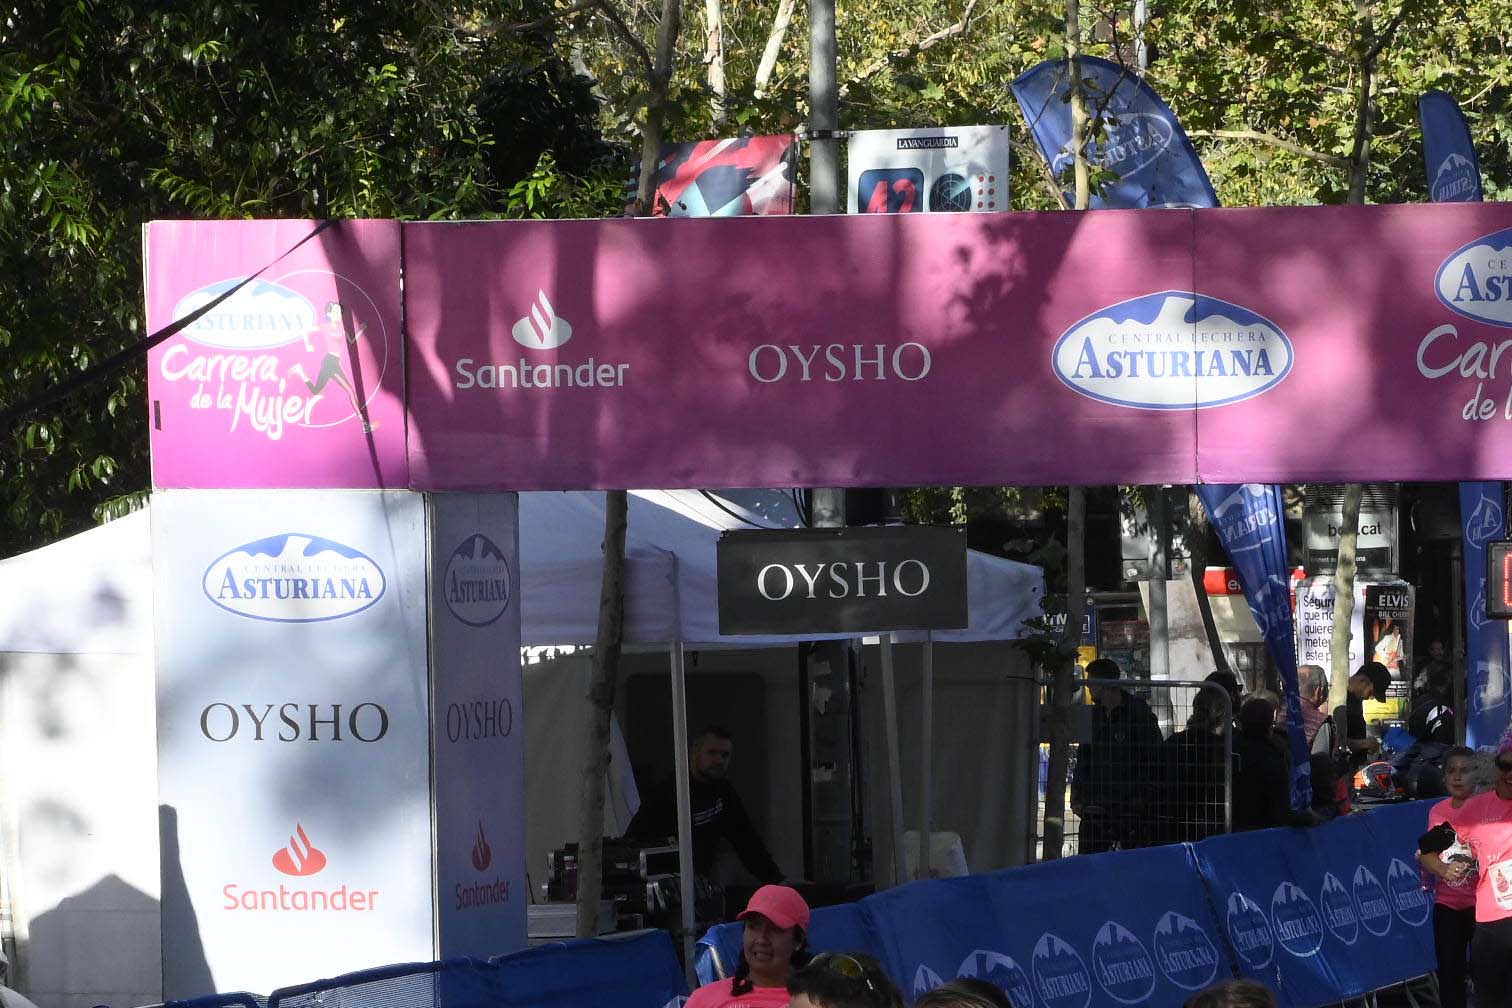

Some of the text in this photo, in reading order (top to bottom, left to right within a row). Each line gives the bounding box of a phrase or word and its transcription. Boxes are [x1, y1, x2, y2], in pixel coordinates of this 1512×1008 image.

[1108, 331, 1266, 344] CENTRAL LECHERA
[160, 344, 279, 381] Carrera
[456, 357, 629, 389] Santander
[748, 341, 932, 384] OYSHO
[1071, 335, 1275, 379] ASTURIANA
[190, 378, 324, 440] de la Mujer
[1462, 384, 1497, 422] de
[217, 566, 373, 600] ASTURIANA
[450, 569, 507, 602] ASTURIANA
[757, 559, 930, 600] OYSHO
[1378, 595, 1409, 606] ELVIS
[199, 702, 389, 742] OYSHO
[446, 697, 513, 743] OYSHO
[222, 884, 380, 910] Santander
[455, 876, 510, 911] Santander
